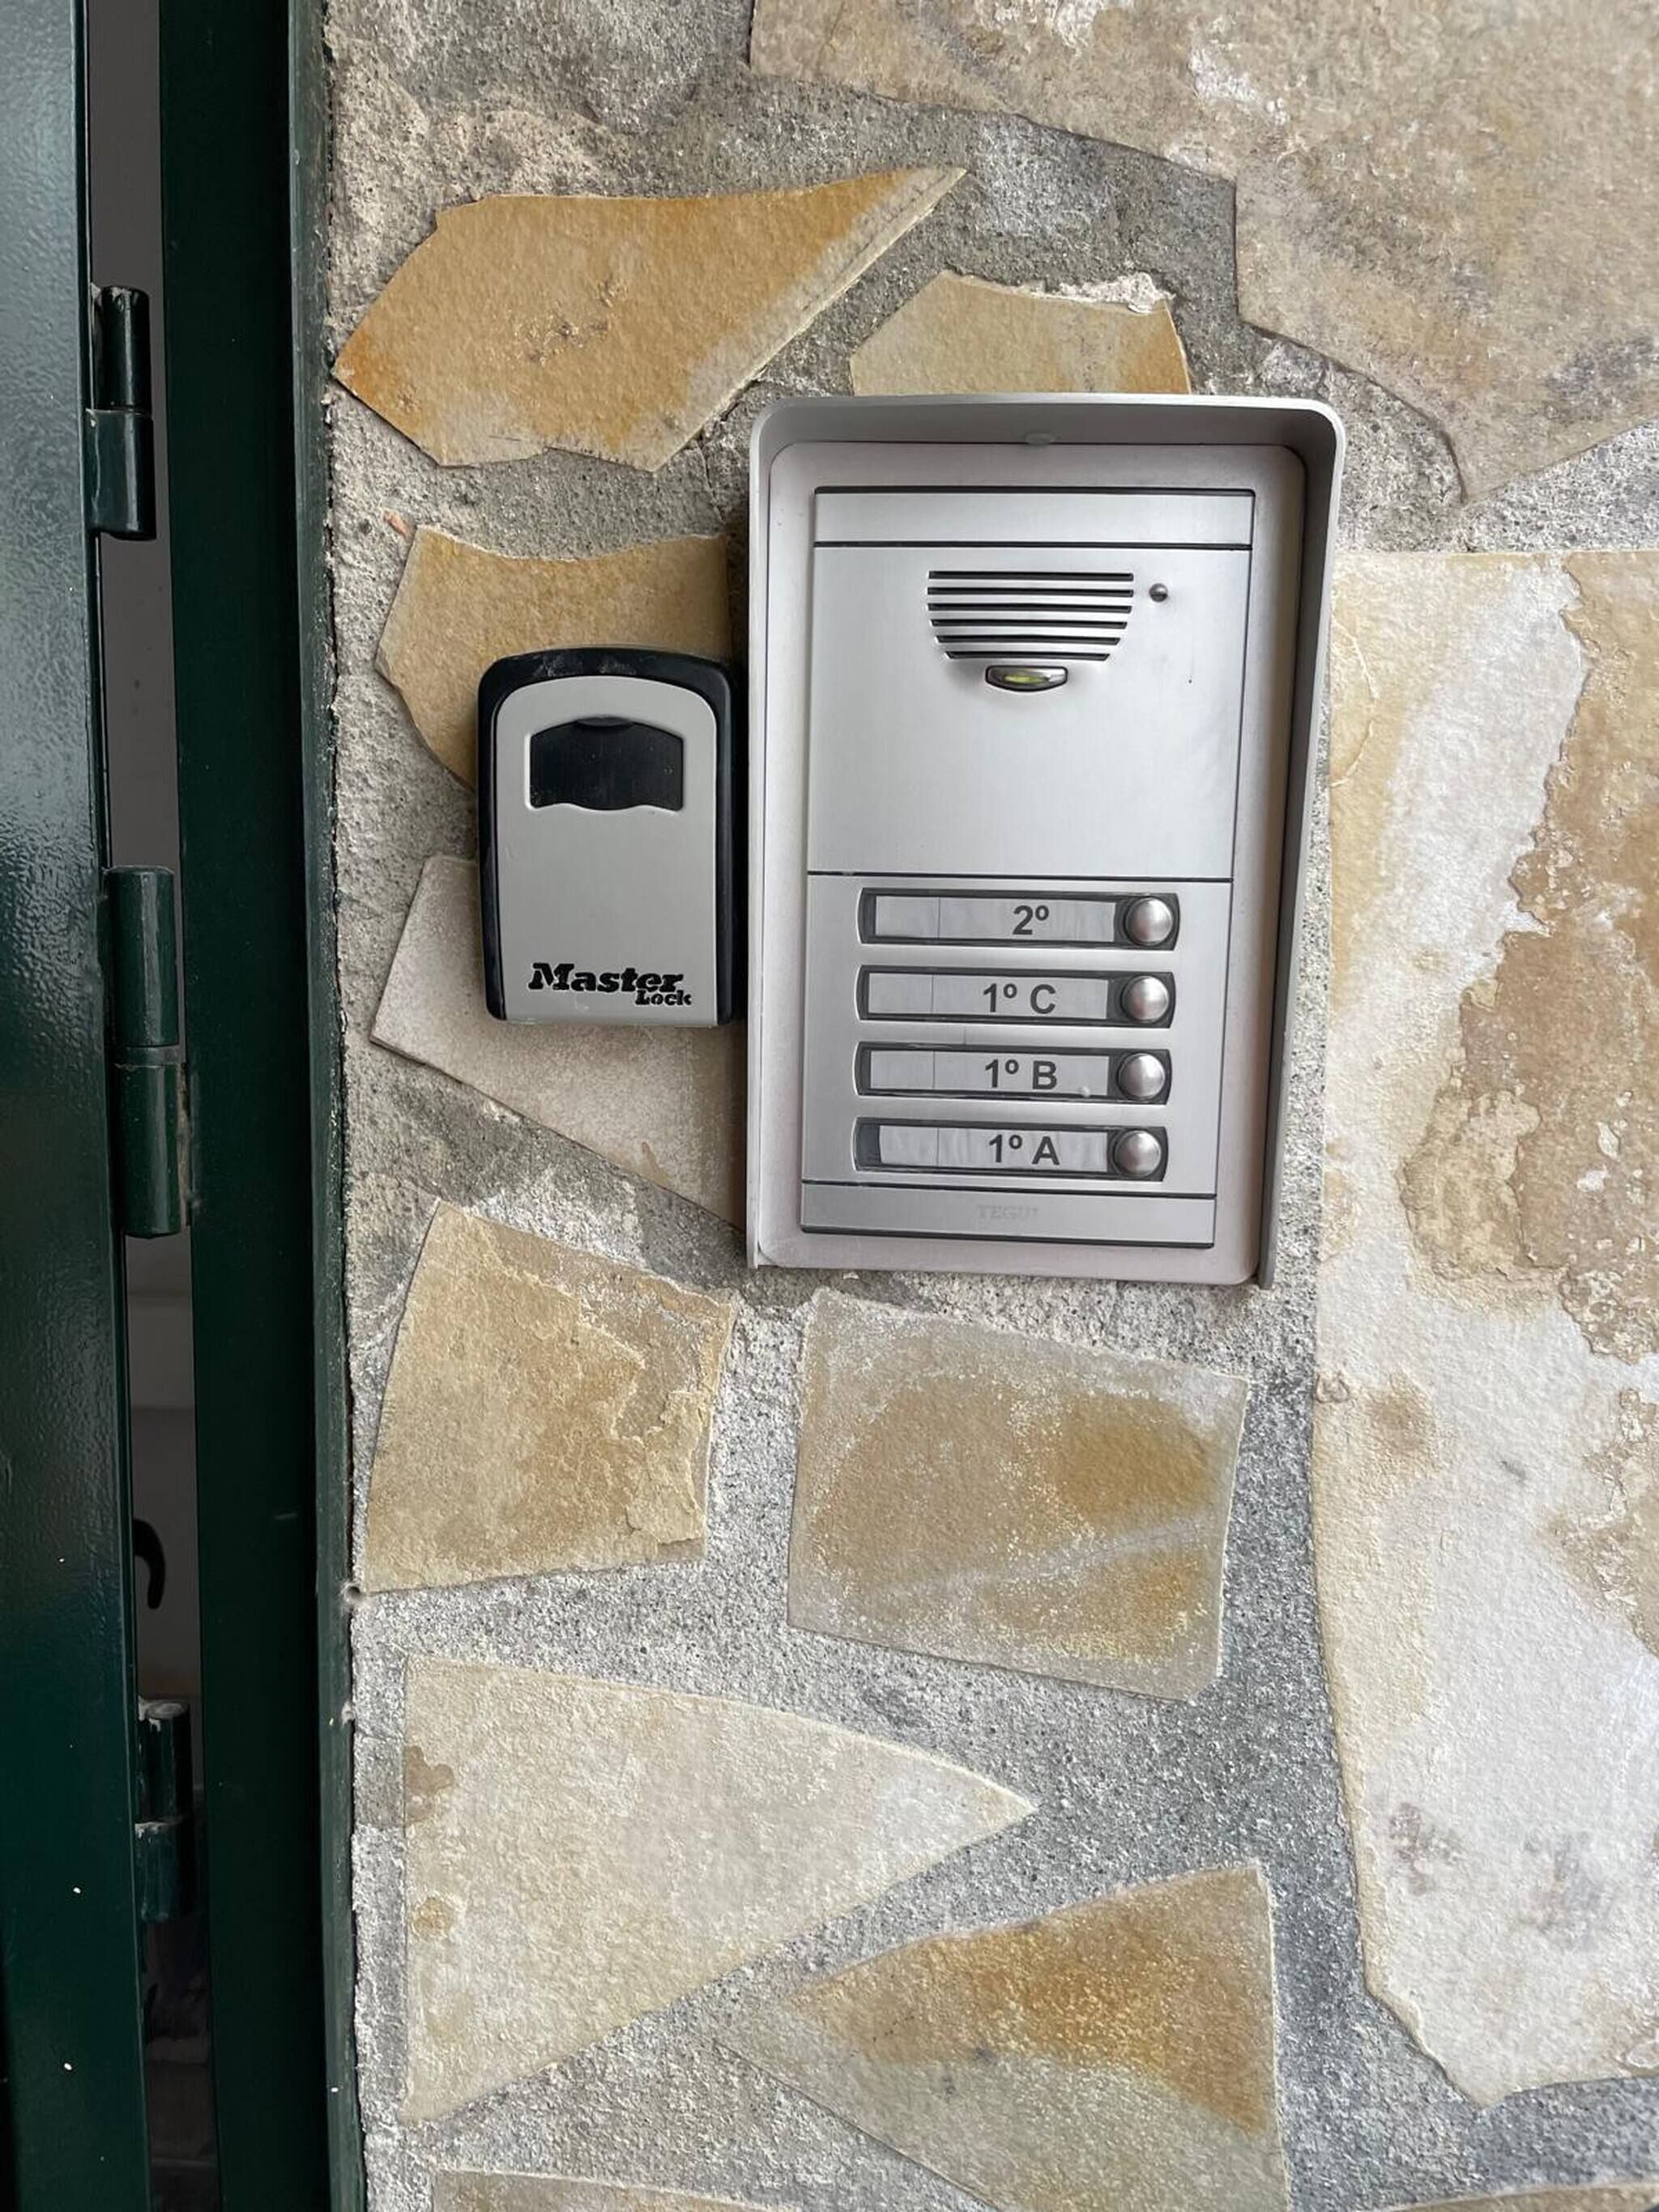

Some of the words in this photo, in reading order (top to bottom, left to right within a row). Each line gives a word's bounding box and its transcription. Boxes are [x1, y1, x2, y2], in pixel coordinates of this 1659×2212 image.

[1012, 905, 1050, 936] 2º
[528, 962, 684, 993] Master
[634, 990, 692, 1006] Lock
[983, 982, 1017, 1013] 1º
[1030, 983, 1056, 1014] C
[984, 1059, 1020, 1088] 1º
[1032, 1059, 1058, 1090] B
[988, 1134, 1023, 1163] 1º
[1031, 1136, 1060, 1166] A
